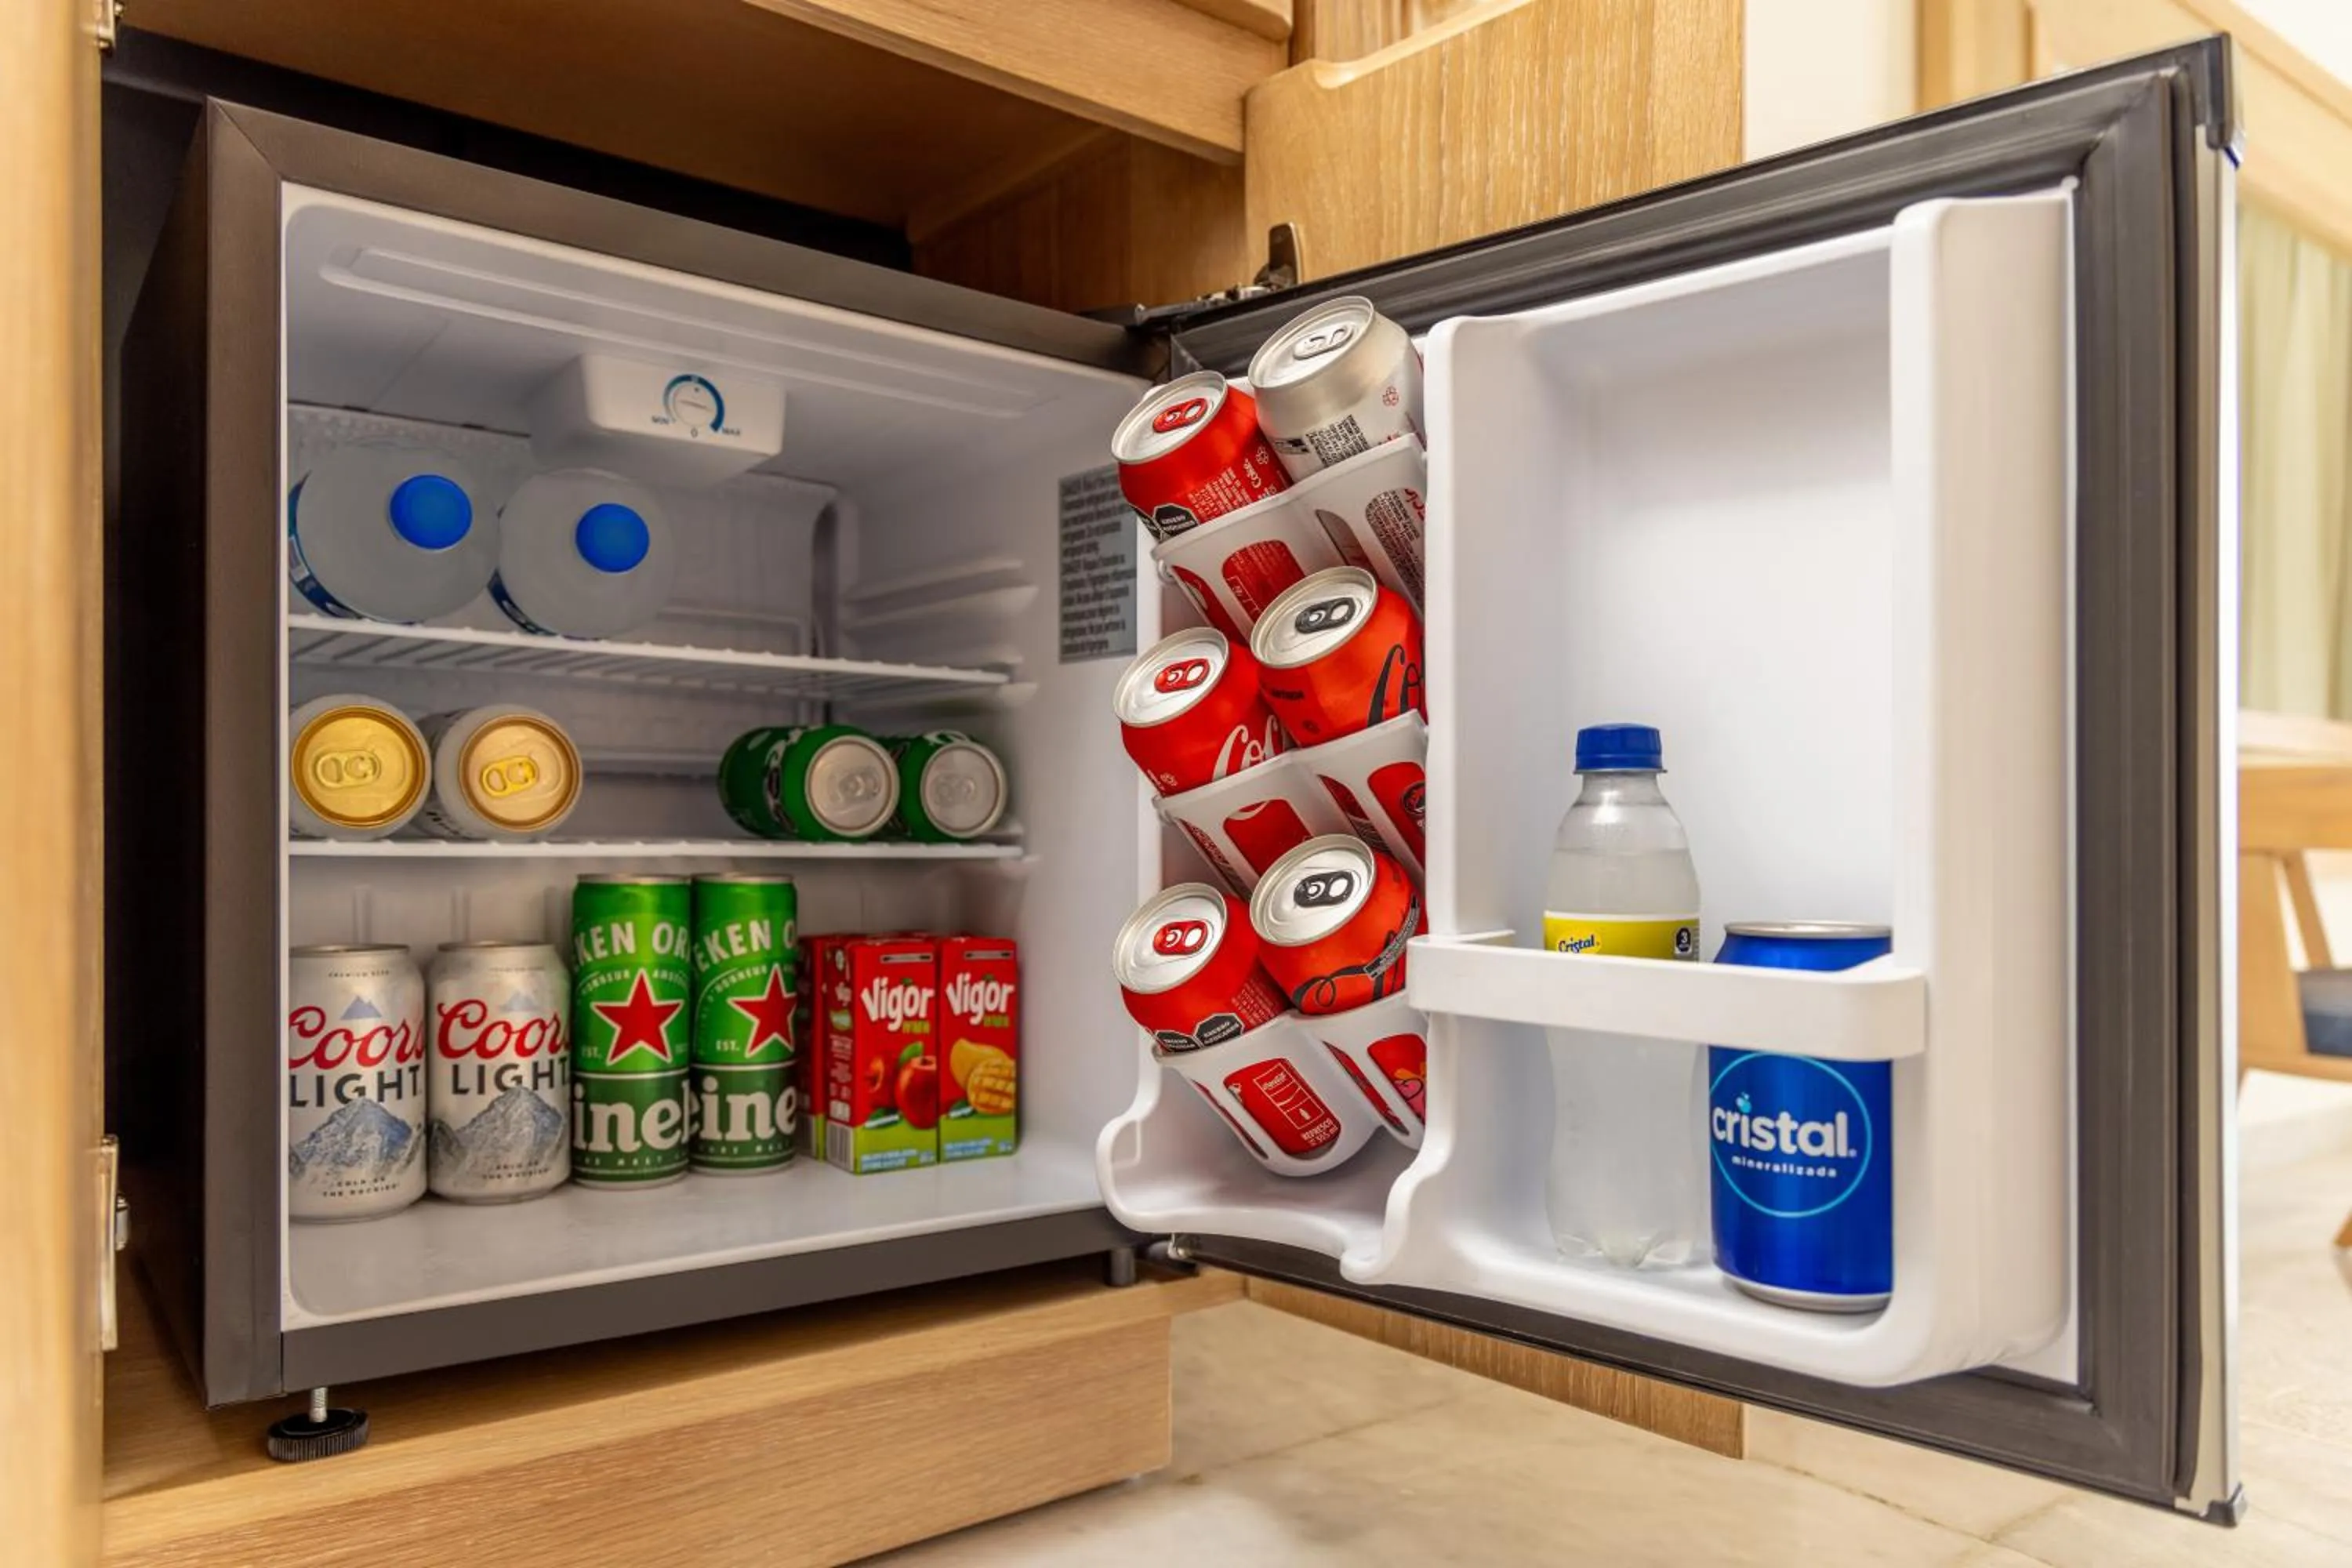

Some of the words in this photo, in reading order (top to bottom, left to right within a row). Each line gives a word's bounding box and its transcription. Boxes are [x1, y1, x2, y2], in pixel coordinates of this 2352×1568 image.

[861, 977, 935, 1032] Vigor
[946, 972, 1014, 1025] Vigor
[289, 1065, 420, 1108] LIGHT
[452, 1057, 568, 1095] LIGHT
[1713, 1098, 1848, 1158] cristal
[1731, 1155, 1838, 1178] mineralizada
